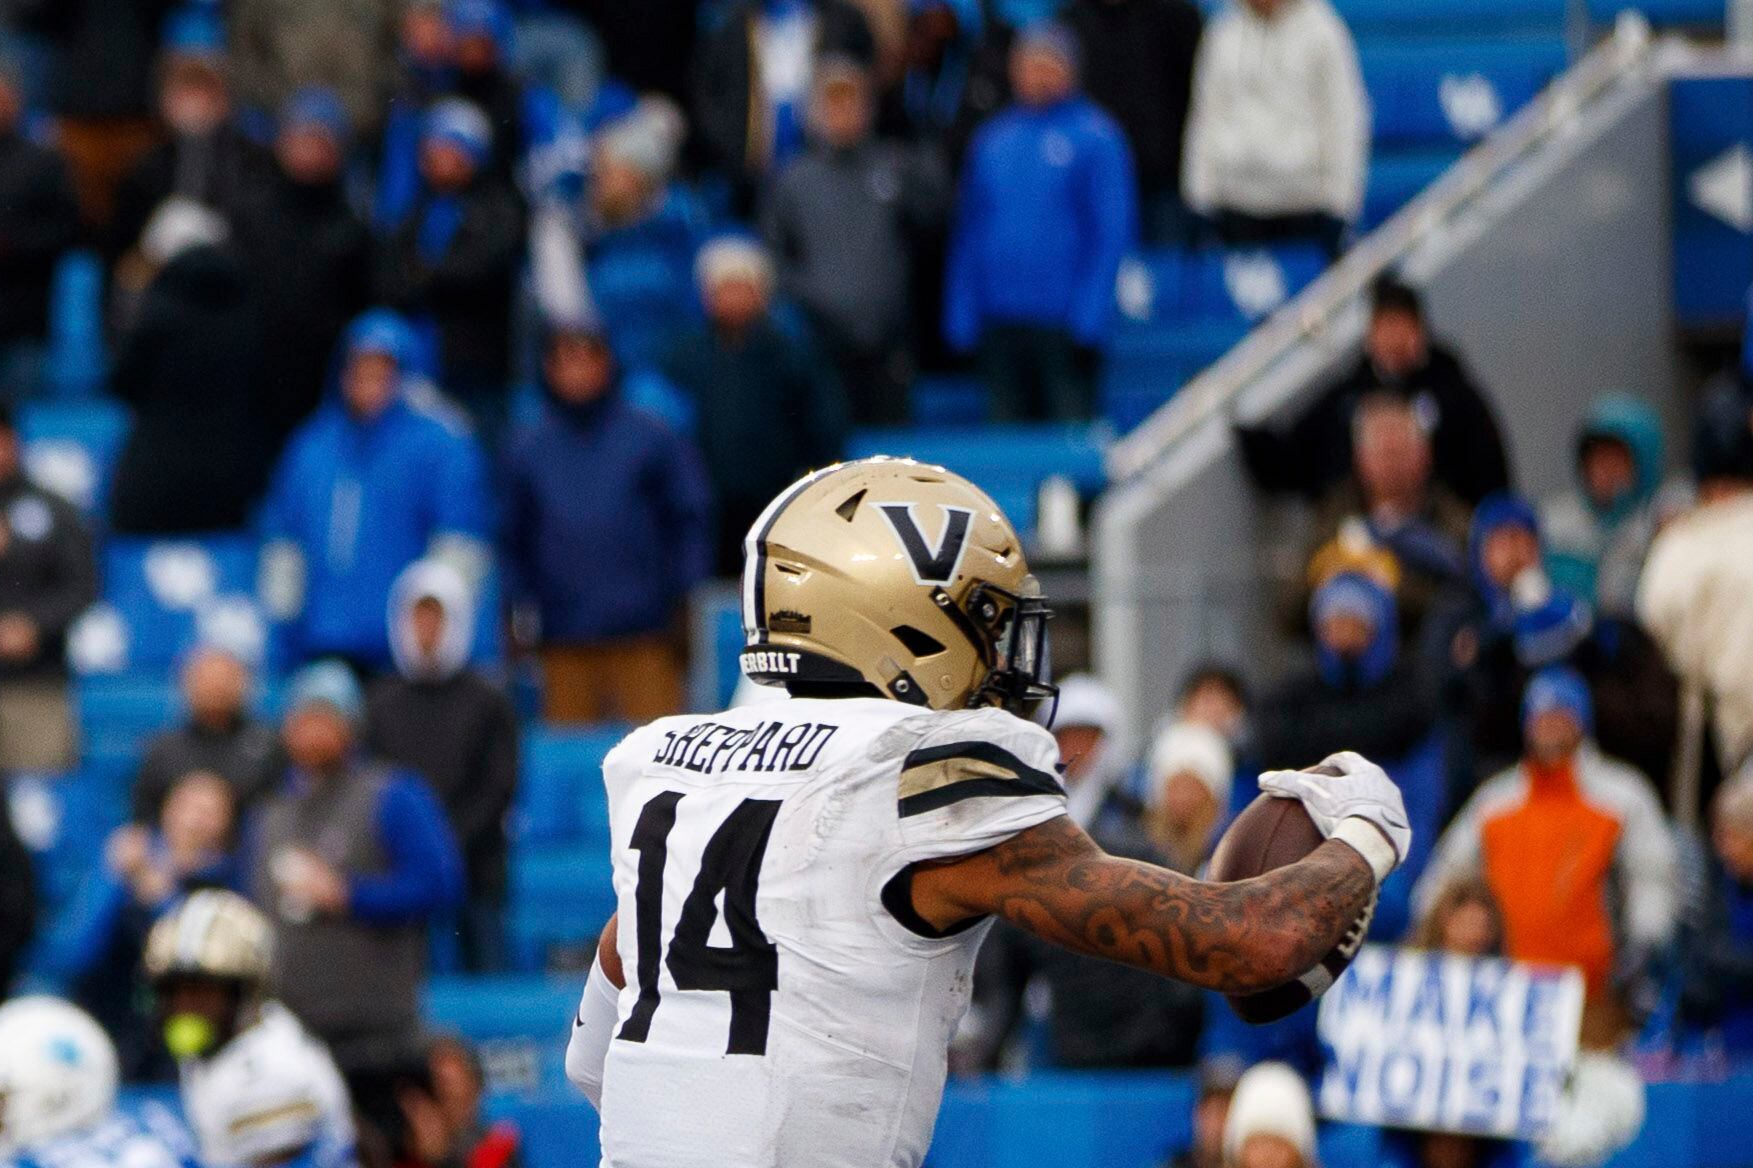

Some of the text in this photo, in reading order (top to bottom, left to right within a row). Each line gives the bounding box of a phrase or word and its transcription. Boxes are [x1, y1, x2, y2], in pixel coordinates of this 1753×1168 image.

[867, 501, 976, 587] V
[653, 720, 840, 774] SHEPPARD
[615, 789, 784, 1056] 14
[1338, 948, 1564, 1054] MAKE
